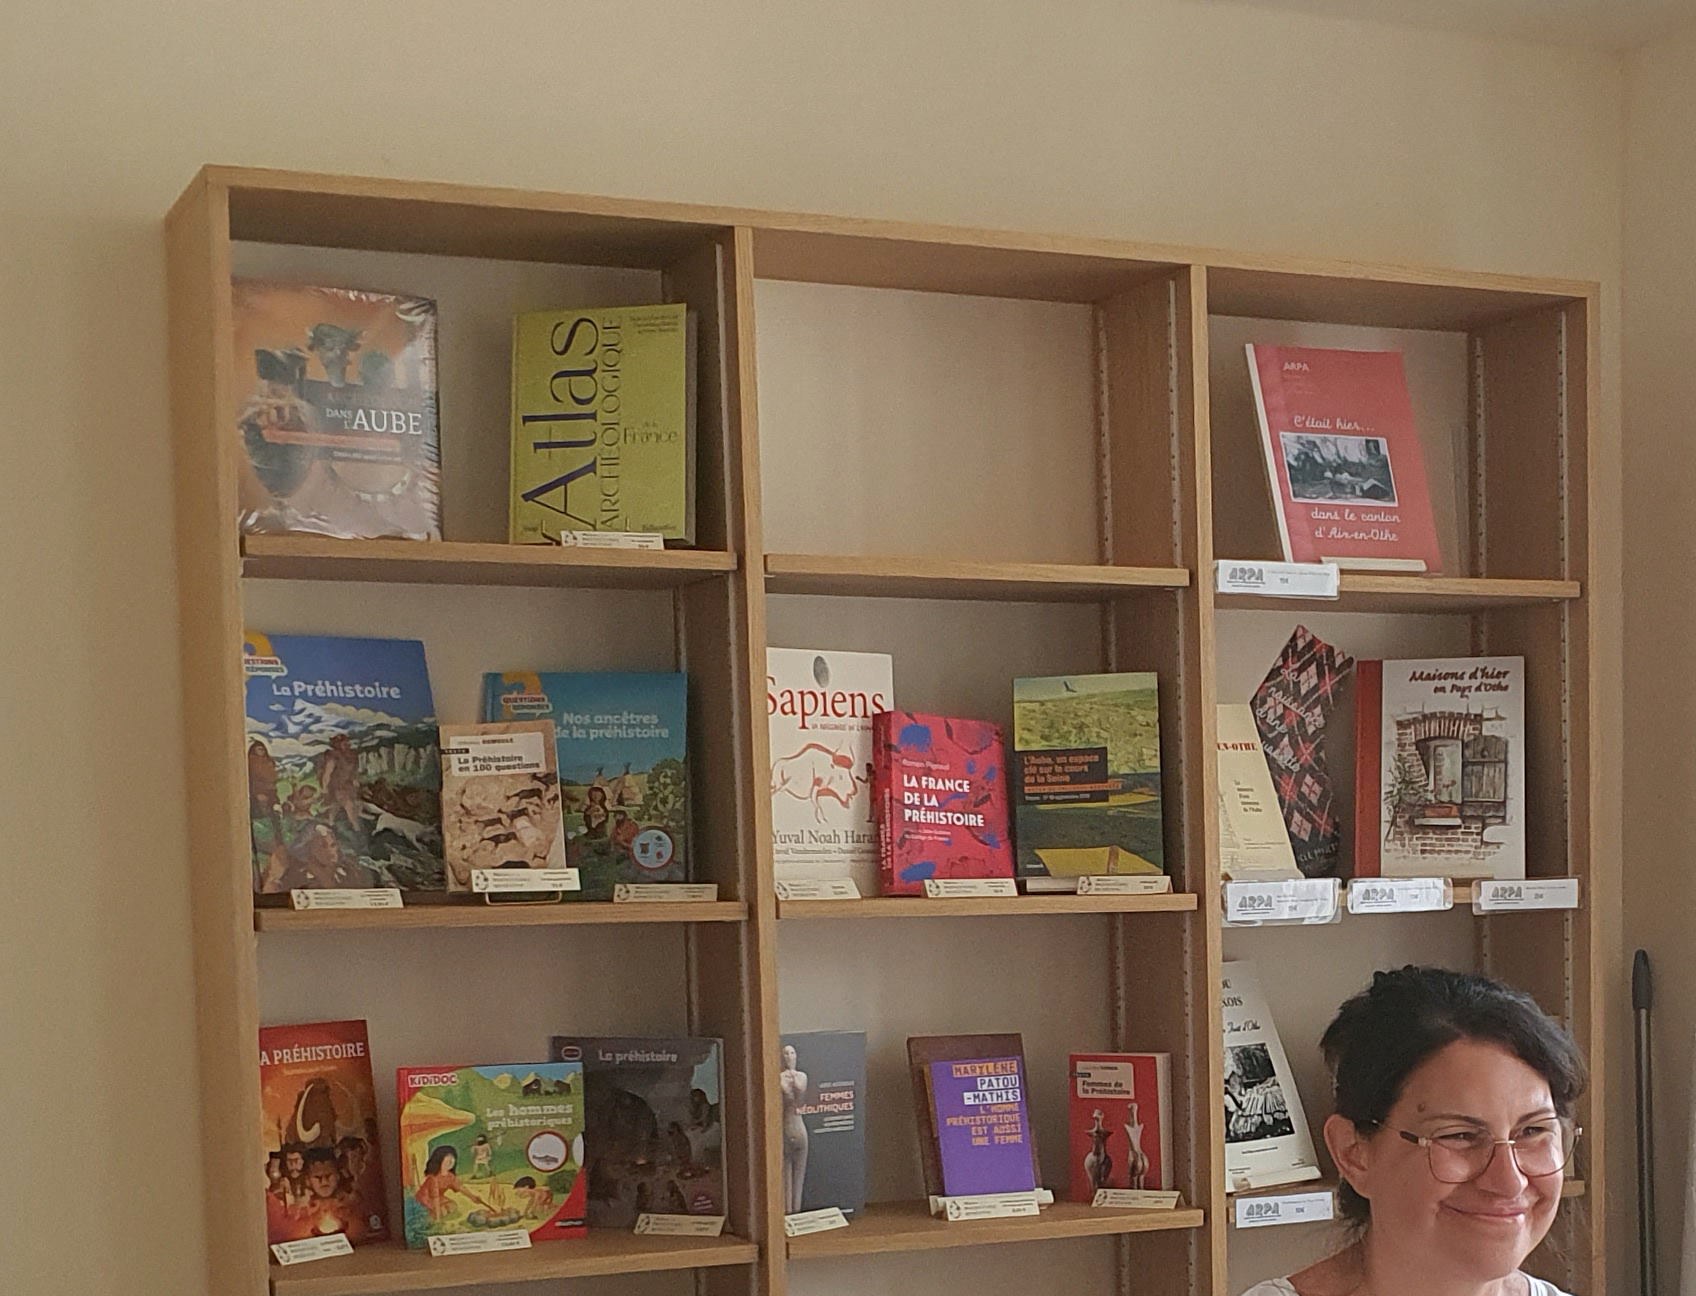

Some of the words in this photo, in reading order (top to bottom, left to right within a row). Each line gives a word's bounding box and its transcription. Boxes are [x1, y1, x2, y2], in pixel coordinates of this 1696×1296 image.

[1283, 361, 1310, 372] ARPA
[326, 408, 352, 419] DANS
[352, 408, 422, 435] AUBE
[521, 317, 599, 531] Atlas
[1294, 415, 1332, 430] C'était
[624, 427, 678, 445] France
[1311, 507, 1340, 520] dans
[1344, 508, 1357, 521] le
[1361, 510, 1401, 523] canton
[1229, 567, 1263, 582] ARPA
[1409, 668, 1466, 683] Maisons
[1469, 666, 1510, 680] d'hier
[272, 682, 292, 697] La
[293, 679, 401, 699] Préhistoire
[1433, 685, 1446, 693] en
[1450, 683, 1473, 699] Pays
[1475, 681, 1509, 692] d'Othe
[503, 696, 546, 704] QUESTIONS
[767, 676, 885, 729] Sapiens
[1268, 687, 1325, 728] naissance
[563, 711, 590, 725] Nos
[594, 711, 659, 725] ancêtres
[554, 728, 570, 739] de
[573, 727, 586, 739] la
[590, 725, 669, 741] préhistoire
[458, 757, 469, 765] La
[472, 755, 523, 764] Préhistoire
[473, 764, 492, 772] 100
[495, 762, 540, 772] questions
[903, 774, 918, 788] LA
[921, 776, 970, 793] FRANCE
[1024, 775, 1035, 783] de
[904, 791, 920, 805] DE
[924, 793, 939, 807] LA
[904, 807, 985, 827] PRÉHISTOIRE
[773, 830, 804, 844] Yuval
[808, 829, 841, 844] Noah
[844, 830, 877, 844] Hara
[1362, 888, 1395, 901] ARPA
[1491, 886, 1523, 899] ARPA
[1239, 895, 1273, 909] ARPA
[274, 1042, 366, 1064] PRÉHISTOIRE
[598, 1049, 613, 1061] La
[615, 1050, 678, 1064] préhistoire
[980, 1076, 1017, 1089] PATOU
[1082, 1080, 1112, 1088] Femmes
[1114, 1080, 1123, 1088] de
[820, 1090, 854, 1101] FEMMES
[966, 1090, 1019, 1103] -MATHIS
[1091, 1087, 1131, 1096] Préhistoire
[486, 1107, 505, 1117] Les
[508, 1103, 573, 1116] hommes
[796, 1102, 854, 1115] NÉOLITHIQUES
[980, 1103, 1019, 1114] L'HOMME
[487, 1116, 573, 1131] préhistoriques
[946, 1113, 1020, 1126] PRÉHISTORIQUE
[971, 1126, 988, 1135] EST
[994, 1123, 1022, 1134] AUSSI
[972, 1136, 990, 1146] UNE
[994, 1134, 1023, 1144] FEMME
[1246, 1202, 1280, 1216] ARPA
